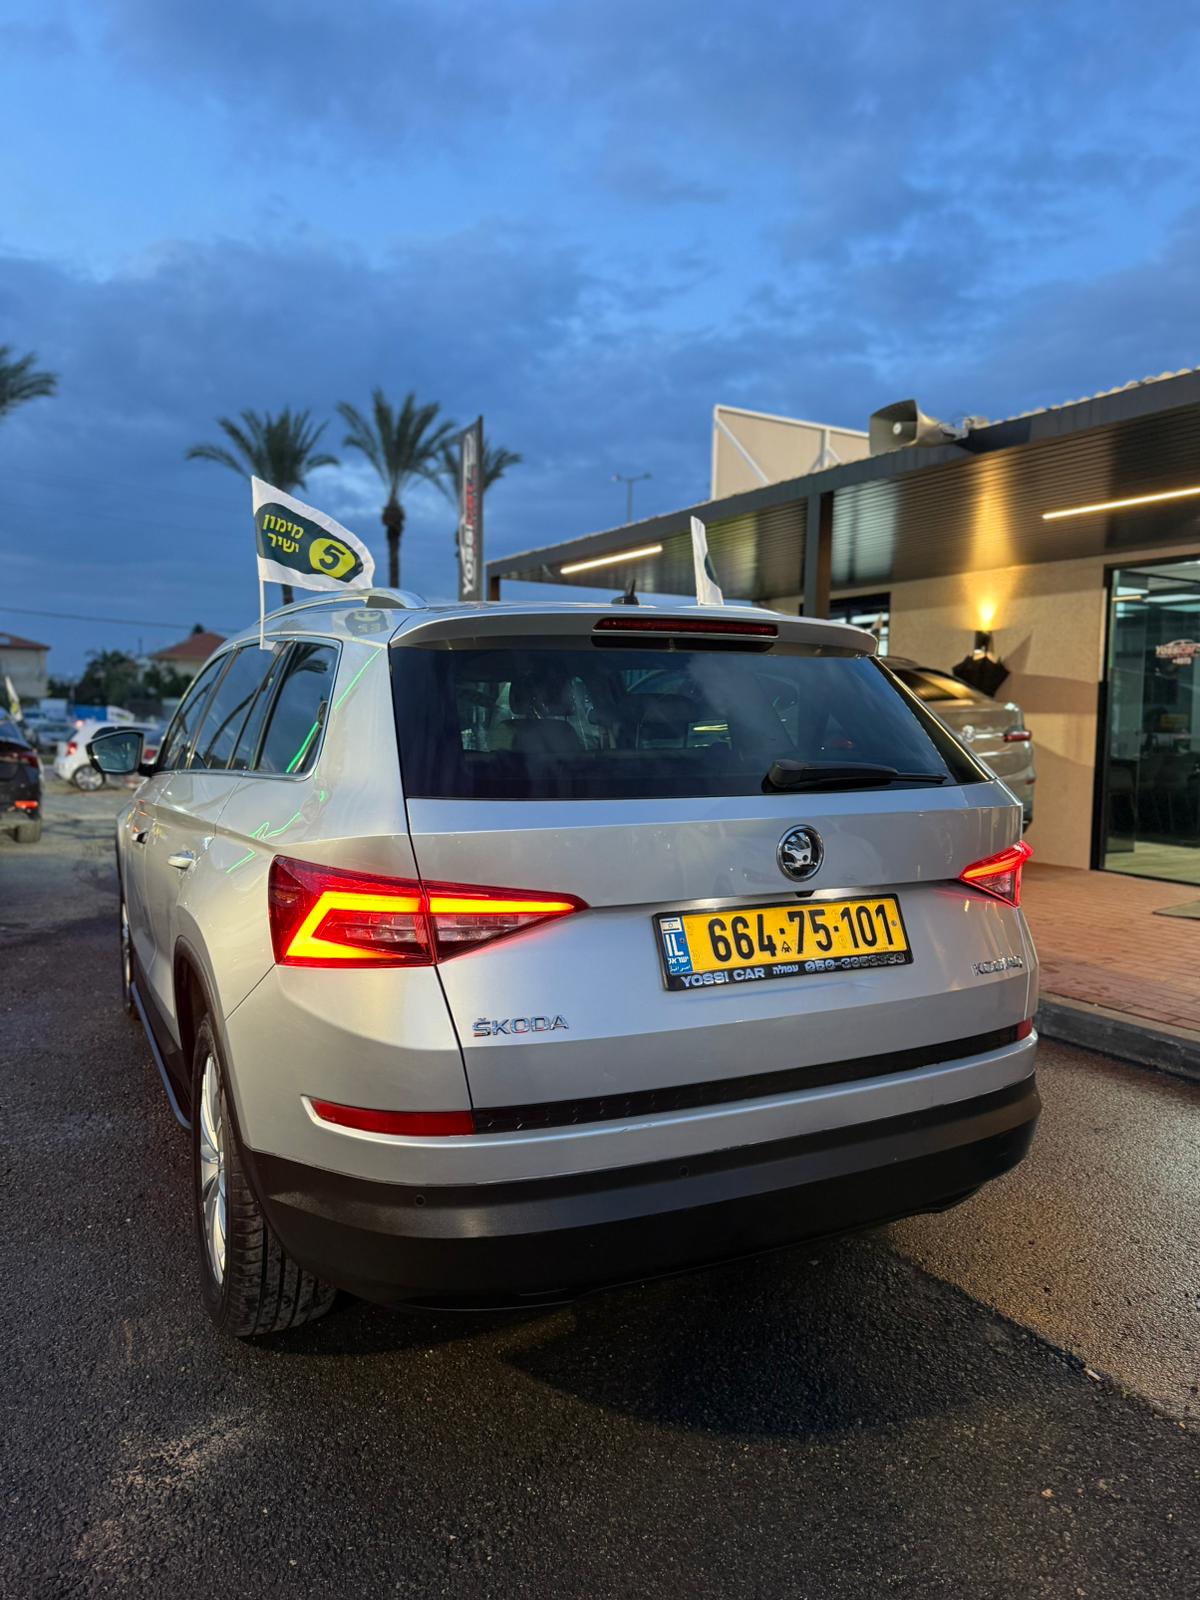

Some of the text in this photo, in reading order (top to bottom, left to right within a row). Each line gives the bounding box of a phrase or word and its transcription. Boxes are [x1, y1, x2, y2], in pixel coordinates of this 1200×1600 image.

[262, 514, 304, 539] מימון
[267, 532, 299, 553] ישיר
[318, 543, 346, 570] 5
[665, 933, 684, 957] IL
[668, 955, 689, 965] ישראל
[681, 970, 729, 987] YOSSI
[733, 967, 765, 981] CAR
[472, 1014, 569, 1037] ŠKODA
